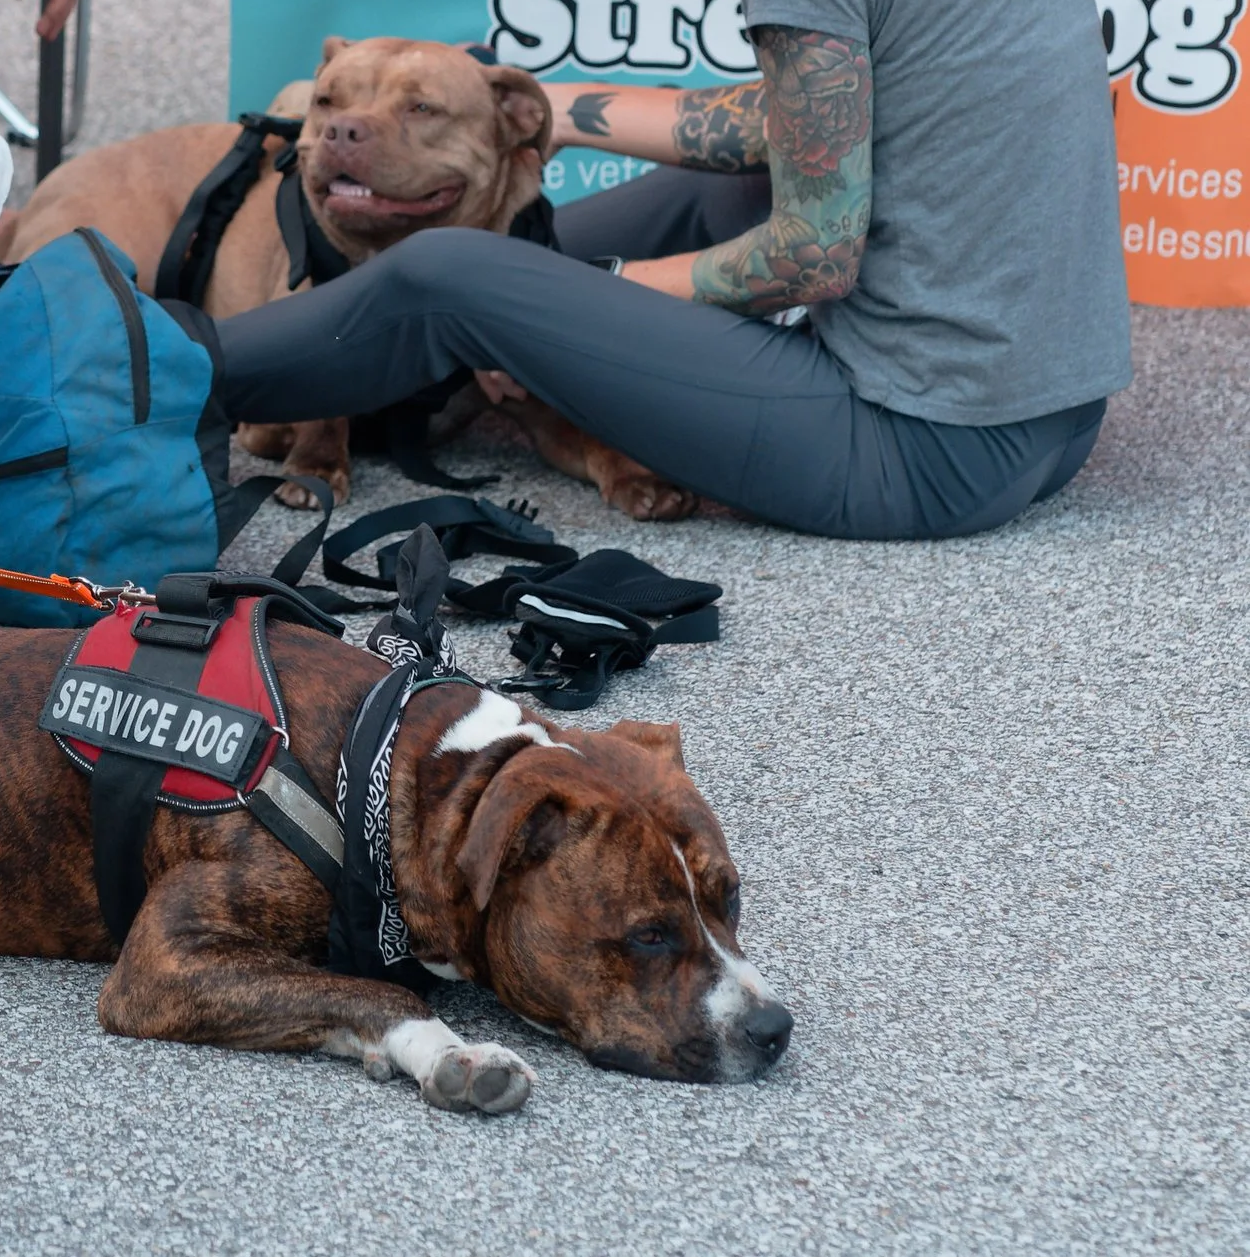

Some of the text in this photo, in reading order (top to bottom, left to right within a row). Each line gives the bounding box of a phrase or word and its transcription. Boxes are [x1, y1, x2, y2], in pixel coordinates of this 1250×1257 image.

[543, 155, 1243, 199] e vet ervices
[1123, 216, 1250, 260] elessn
[52, 678, 244, 765] SERVICE DOG
